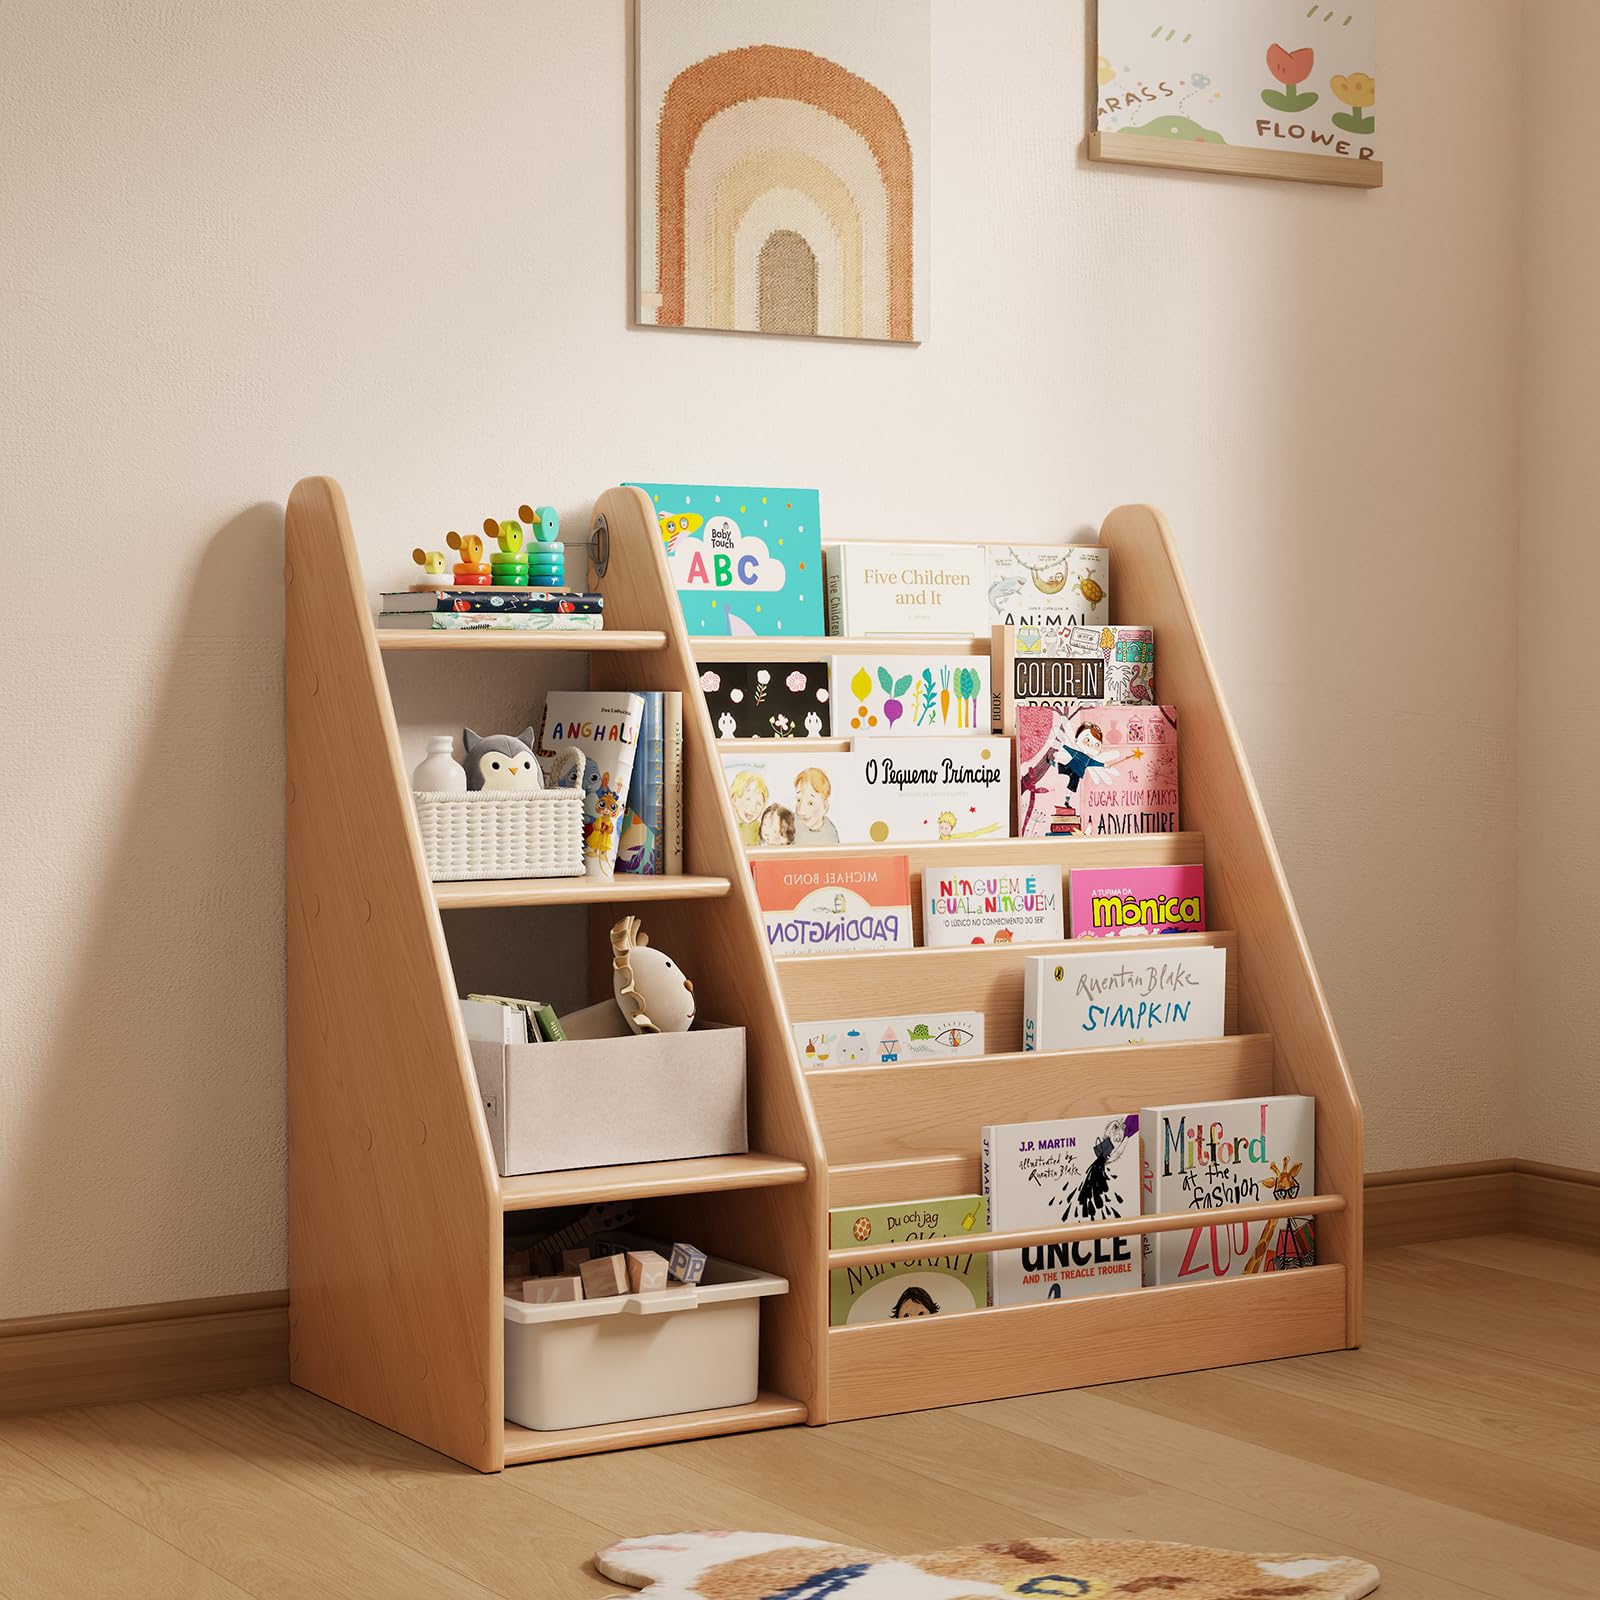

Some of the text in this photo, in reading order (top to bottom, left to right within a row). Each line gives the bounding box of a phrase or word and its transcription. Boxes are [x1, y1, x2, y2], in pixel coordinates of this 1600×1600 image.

[1256, 119, 1375, 161] FLOWER
[711, 538, 735, 549] Touch
[712, 528, 732, 541] Baby
[687, 551, 760, 587] ABC
[864, 569, 971, 586] Five Children
[830, 574, 841, 636] Five Children
[895, 590, 942, 605] and It
[992, 692, 1001, 721] BOOK
[866, 758, 1001, 791] O Pequeno Príncipe
[1128, 770, 1139, 783] The
[1088, 789, 1119, 807] SUGAR
[1121, 789, 1145, 807] PLUM
[1097, 889, 1121, 897] TURMA
[931, 897, 976, 915] IGUAL
[972, 918, 981, 926] NO
[1076, 963, 1200, 1001] Quentin Blake
[1082, 1000, 1191, 1031] SIMPKIN
[1019, 1137, 1076, 1152] J.P. MARTIN
[1162, 1104, 1269, 1177] Mitford
[1182, 1162, 1229, 1191] at the
[1188, 1174, 1260, 1209] fashion
[887, 1210, 939, 1230] Du och jag
[671, 1249, 687, 1273] P
[1021, 1236, 1131, 1272] UNCLE
[687, 1258, 704, 1280] P
[1022, 1263, 1132, 1285] AND THE TREACLE TROUBLE
